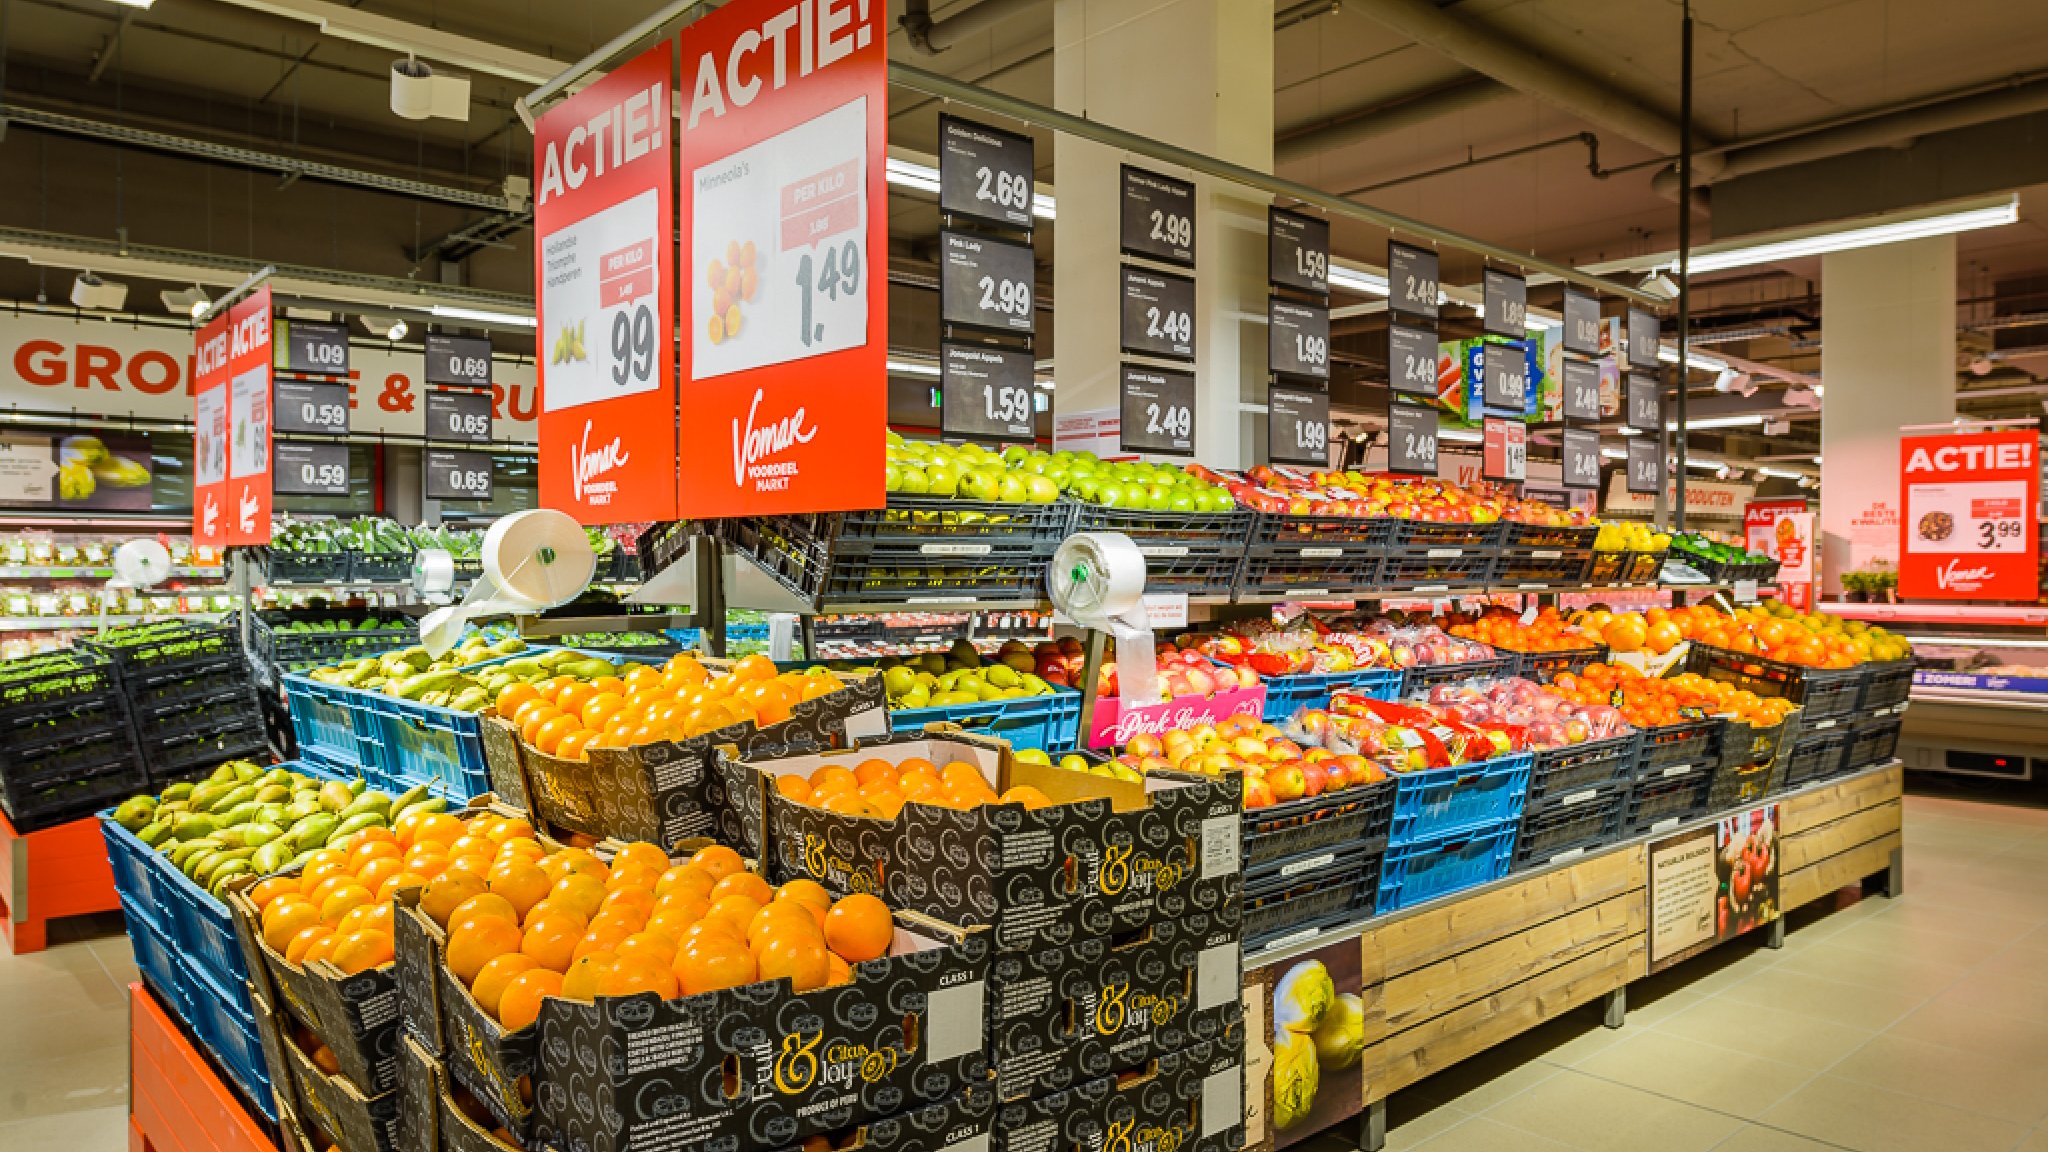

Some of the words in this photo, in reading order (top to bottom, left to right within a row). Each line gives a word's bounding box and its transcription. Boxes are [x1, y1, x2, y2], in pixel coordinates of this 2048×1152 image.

[688, 0, 872, 130] ACTIE!
[540, 81, 663, 206] ACTIE!
[793, 182, 817, 206] PER
[817, 171, 846, 199] KILO
[976, 165, 1027, 210] 2.69
[1149, 209, 1191, 248] 2.99
[608, 255, 625, 272] PER
[1295, 246, 1326, 281] 1.59
[978, 275, 1030, 316] 2.99
[1405, 274, 1437, 306] 2.49
[231, 306, 270, 360] ACTIE!
[1146, 306, 1192, 342] 2.49
[305, 342, 345, 364] 1.09
[612, 304, 654, 386] 99
[1296, 333, 1327, 365] 1.99
[449, 356, 488, 377] 0.69
[1405, 354, 1436, 384] 2.49
[377, 372, 417, 413] &
[984, 384, 1029, 422] 1.59
[301, 402, 346, 425] 0.59
[449, 413, 489, 434] 0.65
[1146, 402, 1191, 437] 2.49
[1295, 420, 1326, 450] 1.99
[1405, 432, 1436, 461] 2.49
[747, 461, 799, 479] VOORDEEL
[1904, 442, 2033, 474] ACTIE!
[301, 464, 346, 485] 0.59
[449, 469, 489, 490] 0.65
[756, 476, 789, 492] MARKT
[589, 493, 612, 506] MARKT
[1977, 520, 2022, 550] 3.99
[1100, 707, 1171, 742] Pink
[751, 1038, 774, 1102] Fruit
[774, 1028, 823, 1095] &
[818, 1060, 854, 1090] Joy
